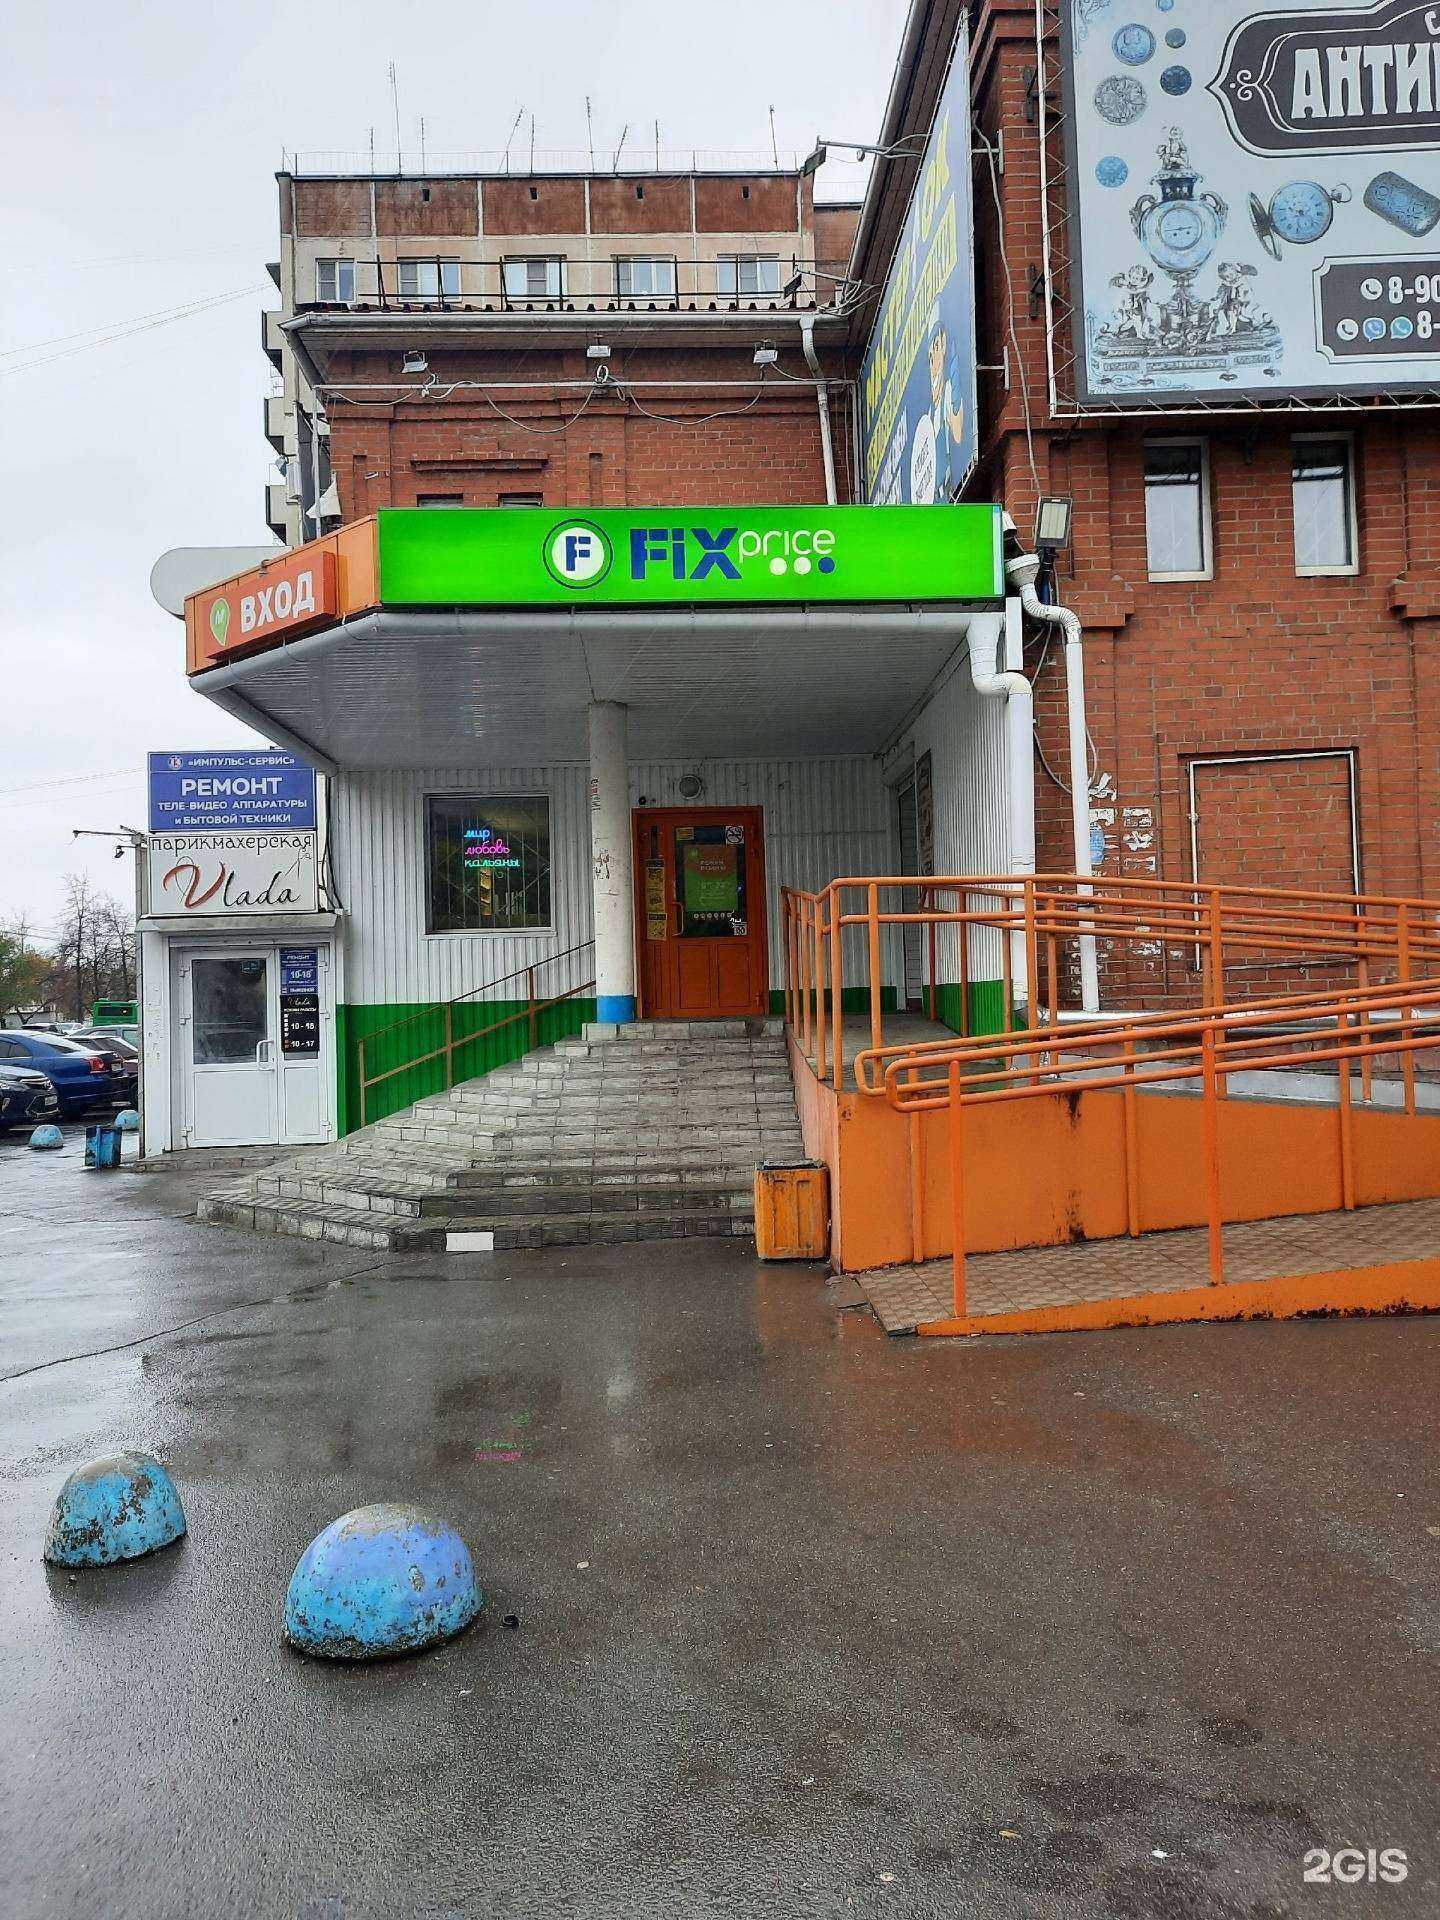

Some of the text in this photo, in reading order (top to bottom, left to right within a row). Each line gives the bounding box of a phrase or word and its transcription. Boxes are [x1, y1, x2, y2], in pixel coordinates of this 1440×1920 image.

[1291, 41, 1440, 119] АНТИ
[739, 529, 836, 564] price
[240, 570, 316, 634] ВХОД
[181, 777, 283, 797] РЕМОНТ
[158, 799, 308, 811] ТЕЛЕ-ВИДЕО АППАРАТУРЫ
[183, 812, 238, 825] БЫТОВОЙ
[240, 813, 291, 824] ТЕХНИКИ
[151, 835, 312, 857] парикмахерская
[465, 838, 511, 856] любовь
[464, 858, 521, 868] кальяны
[162, 860, 300, 910] Vlada
